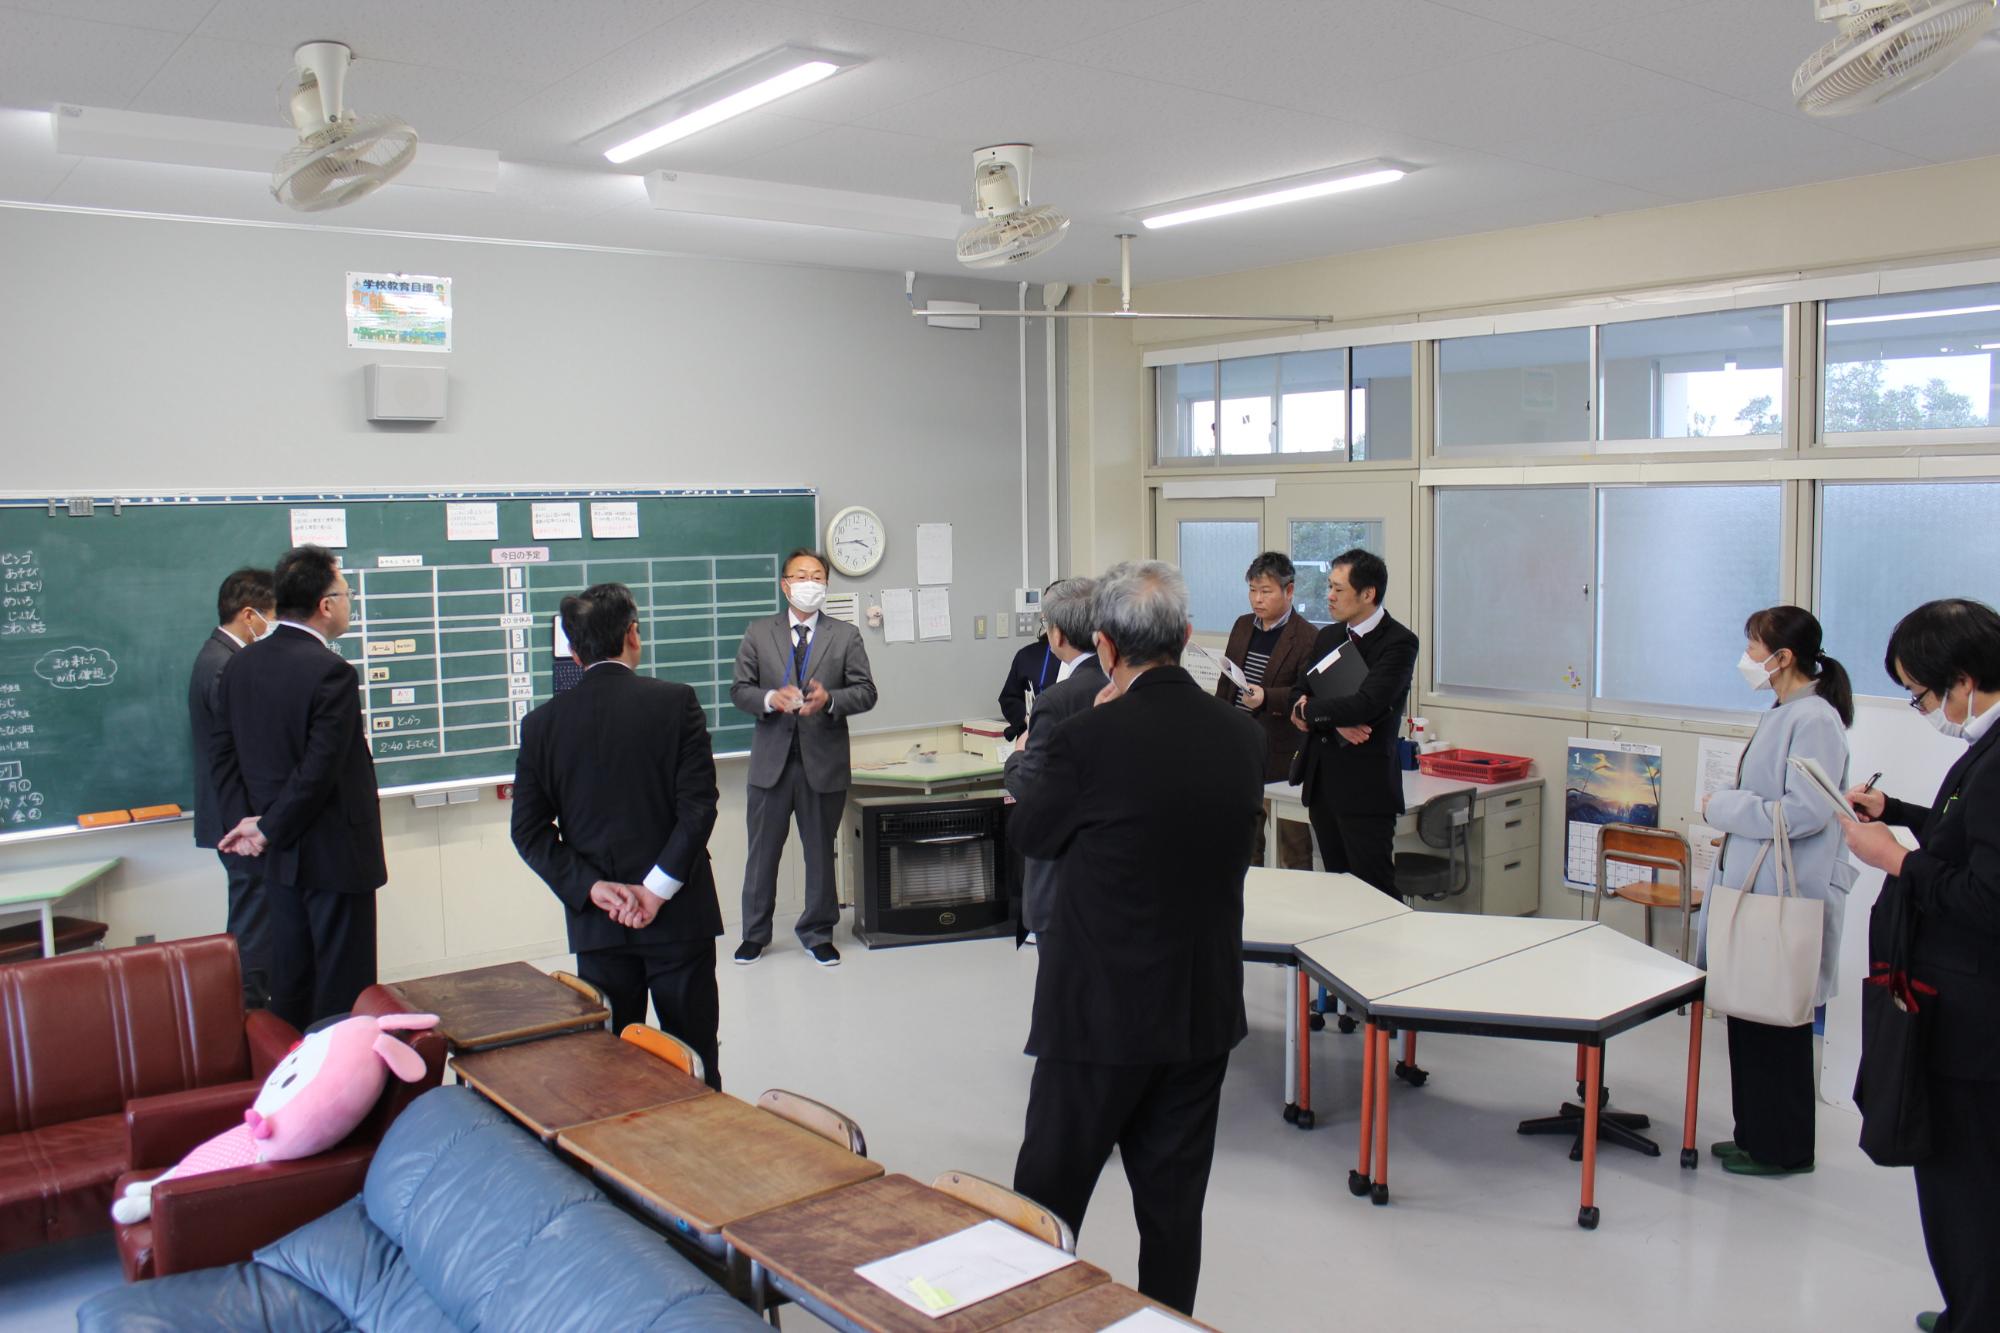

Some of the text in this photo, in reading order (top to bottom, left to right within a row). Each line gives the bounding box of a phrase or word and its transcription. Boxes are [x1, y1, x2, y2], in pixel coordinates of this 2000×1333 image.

[363, 279, 434, 293] 学校教育目標
[500, 550, 541, 560] 今日の予定
[514, 598, 521, 607] 2
[515, 633, 521, 642] 3
[515, 656, 522, 666] 4
[518, 705, 525, 714] 5
[379, 741, 403, 752] 2:40
[1573, 752, 1580, 764] 1
